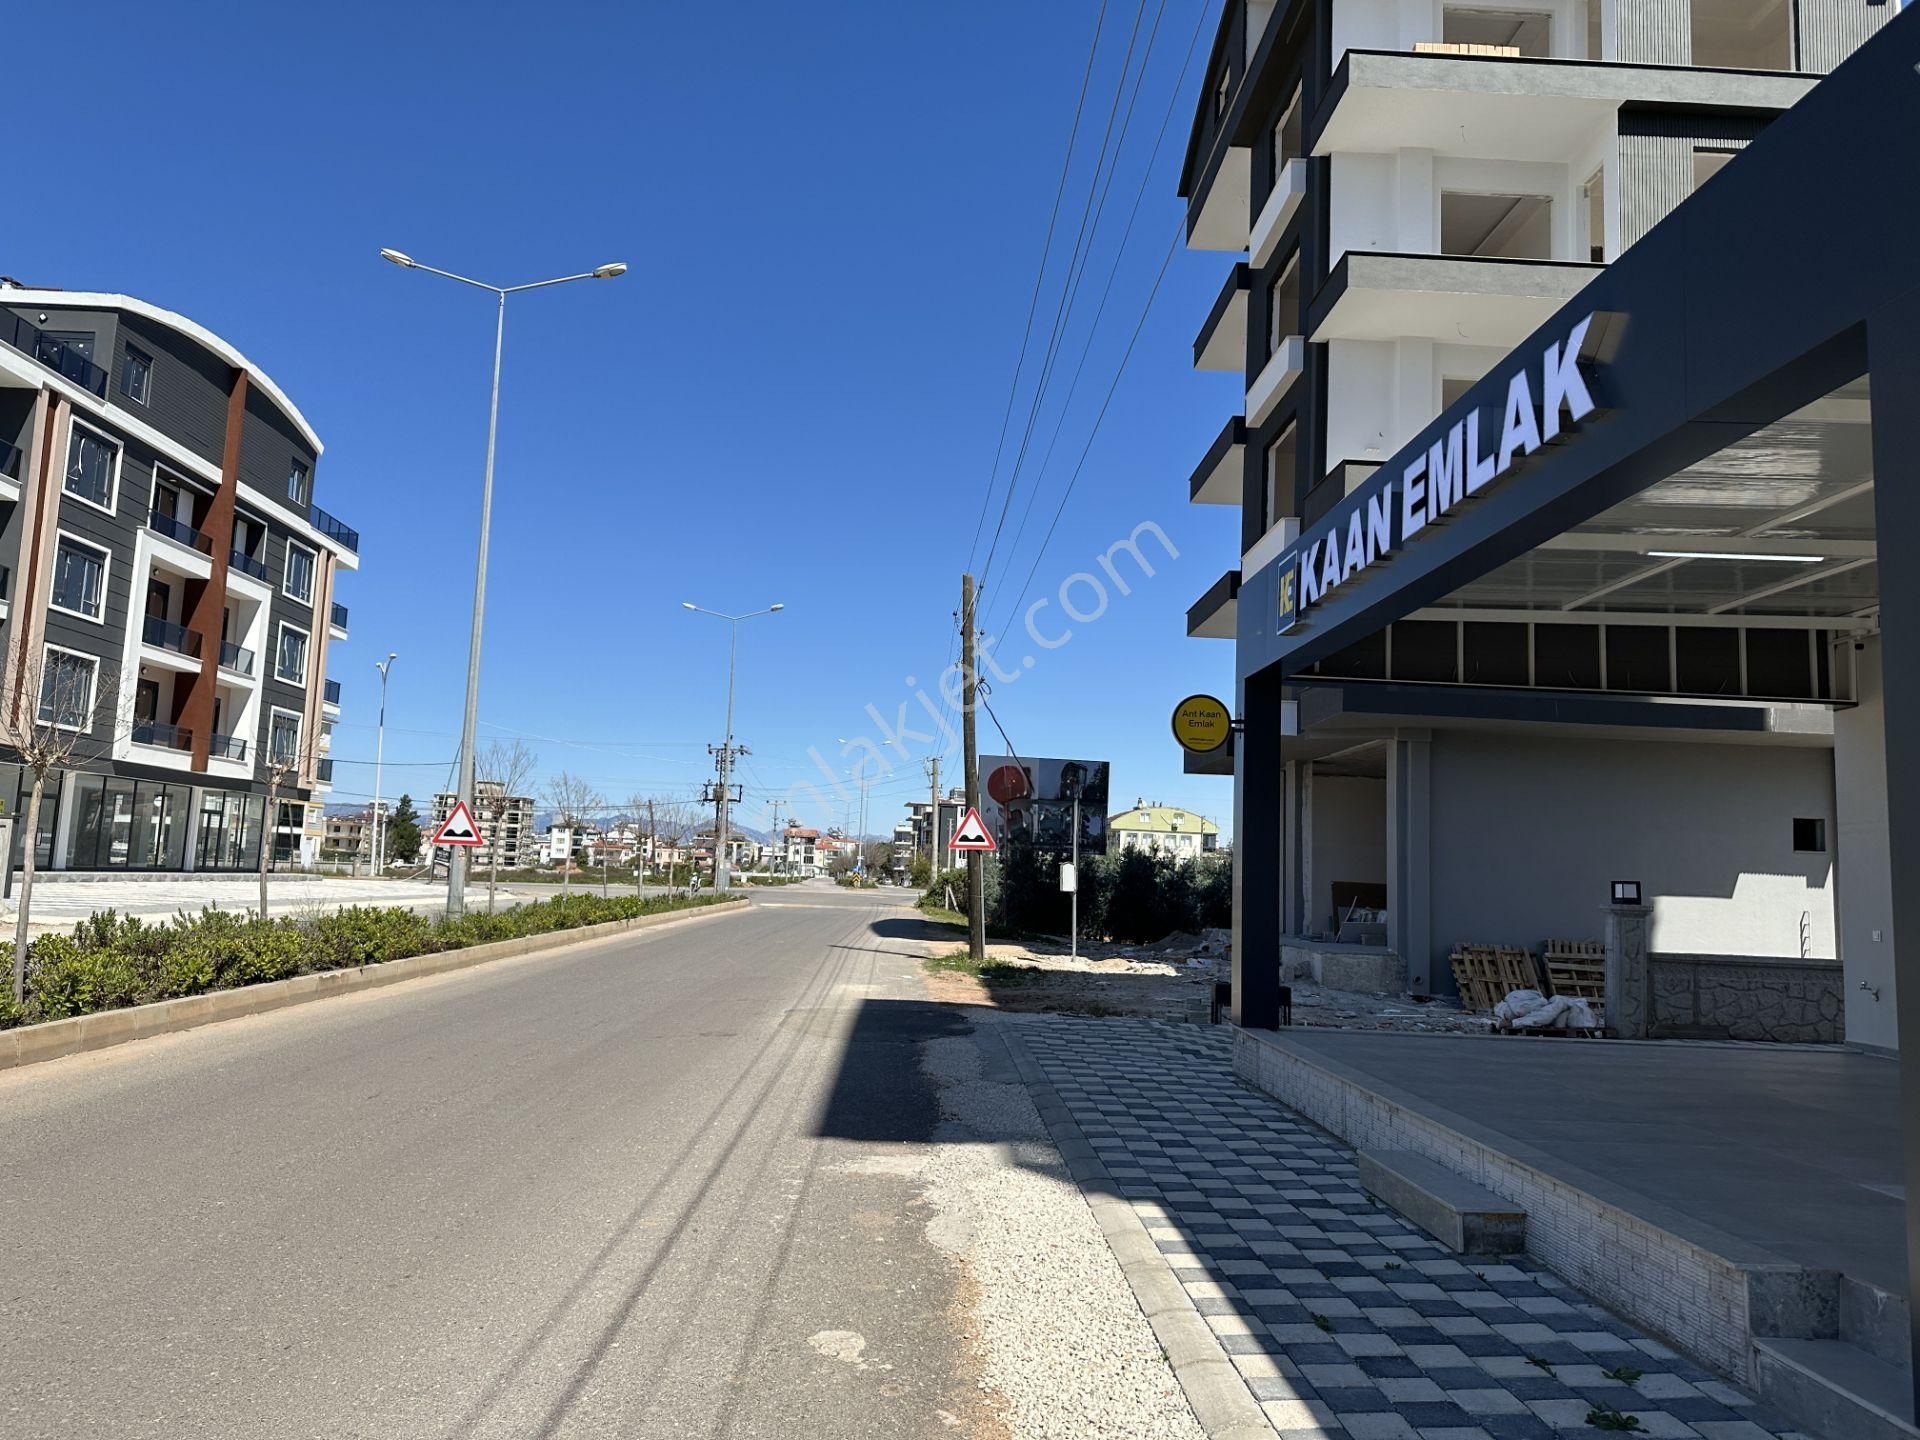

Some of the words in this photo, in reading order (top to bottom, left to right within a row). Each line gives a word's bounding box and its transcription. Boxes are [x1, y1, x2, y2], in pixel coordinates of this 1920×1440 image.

[1299, 481, 1393, 611] KAAN
[1401, 312, 1596, 542] EMLAK
[1182, 710, 1198, 719] Ant
[1199, 710, 1222, 719] Kaan
[1188, 719, 1215, 728] Emlak
